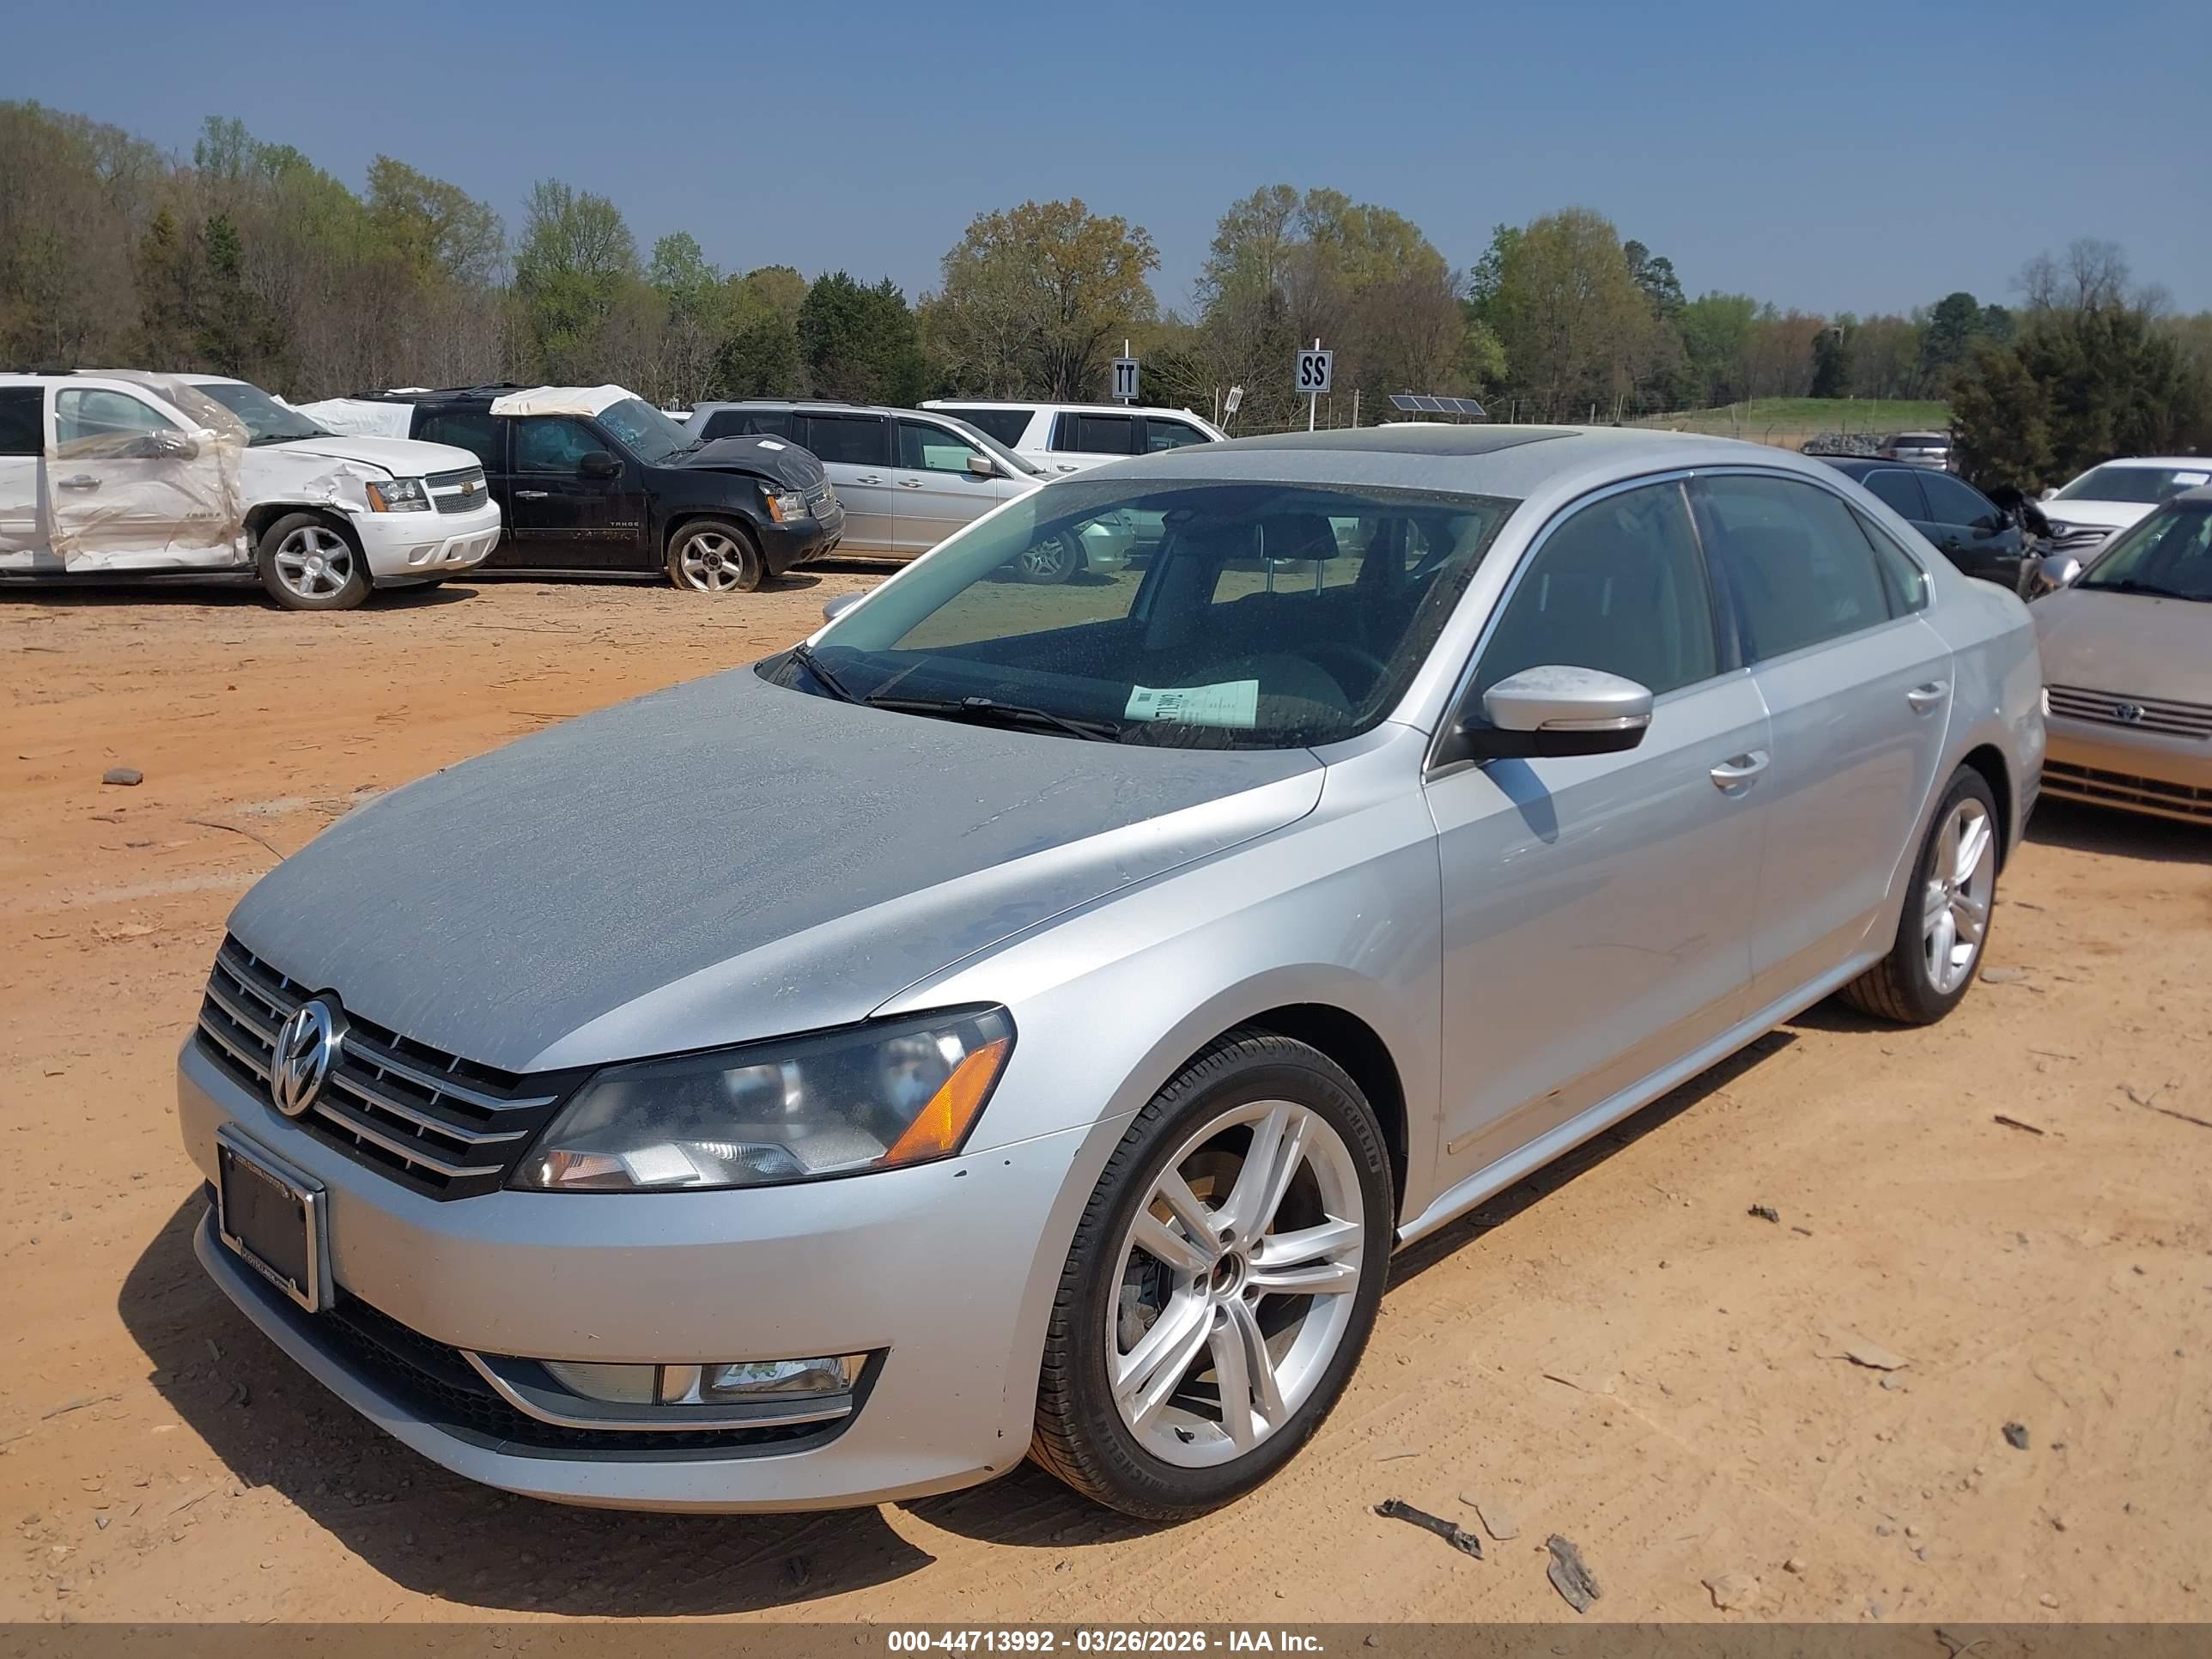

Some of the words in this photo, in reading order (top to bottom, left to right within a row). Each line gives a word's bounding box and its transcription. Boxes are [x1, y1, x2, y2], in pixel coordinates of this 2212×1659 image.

[1116, 364, 1135, 392] TT
[1301, 356, 1326, 386] SS
[1327, 1089, 1380, 1170] MICHELIN
[1093, 1419, 1165, 1490] MICHELIN
